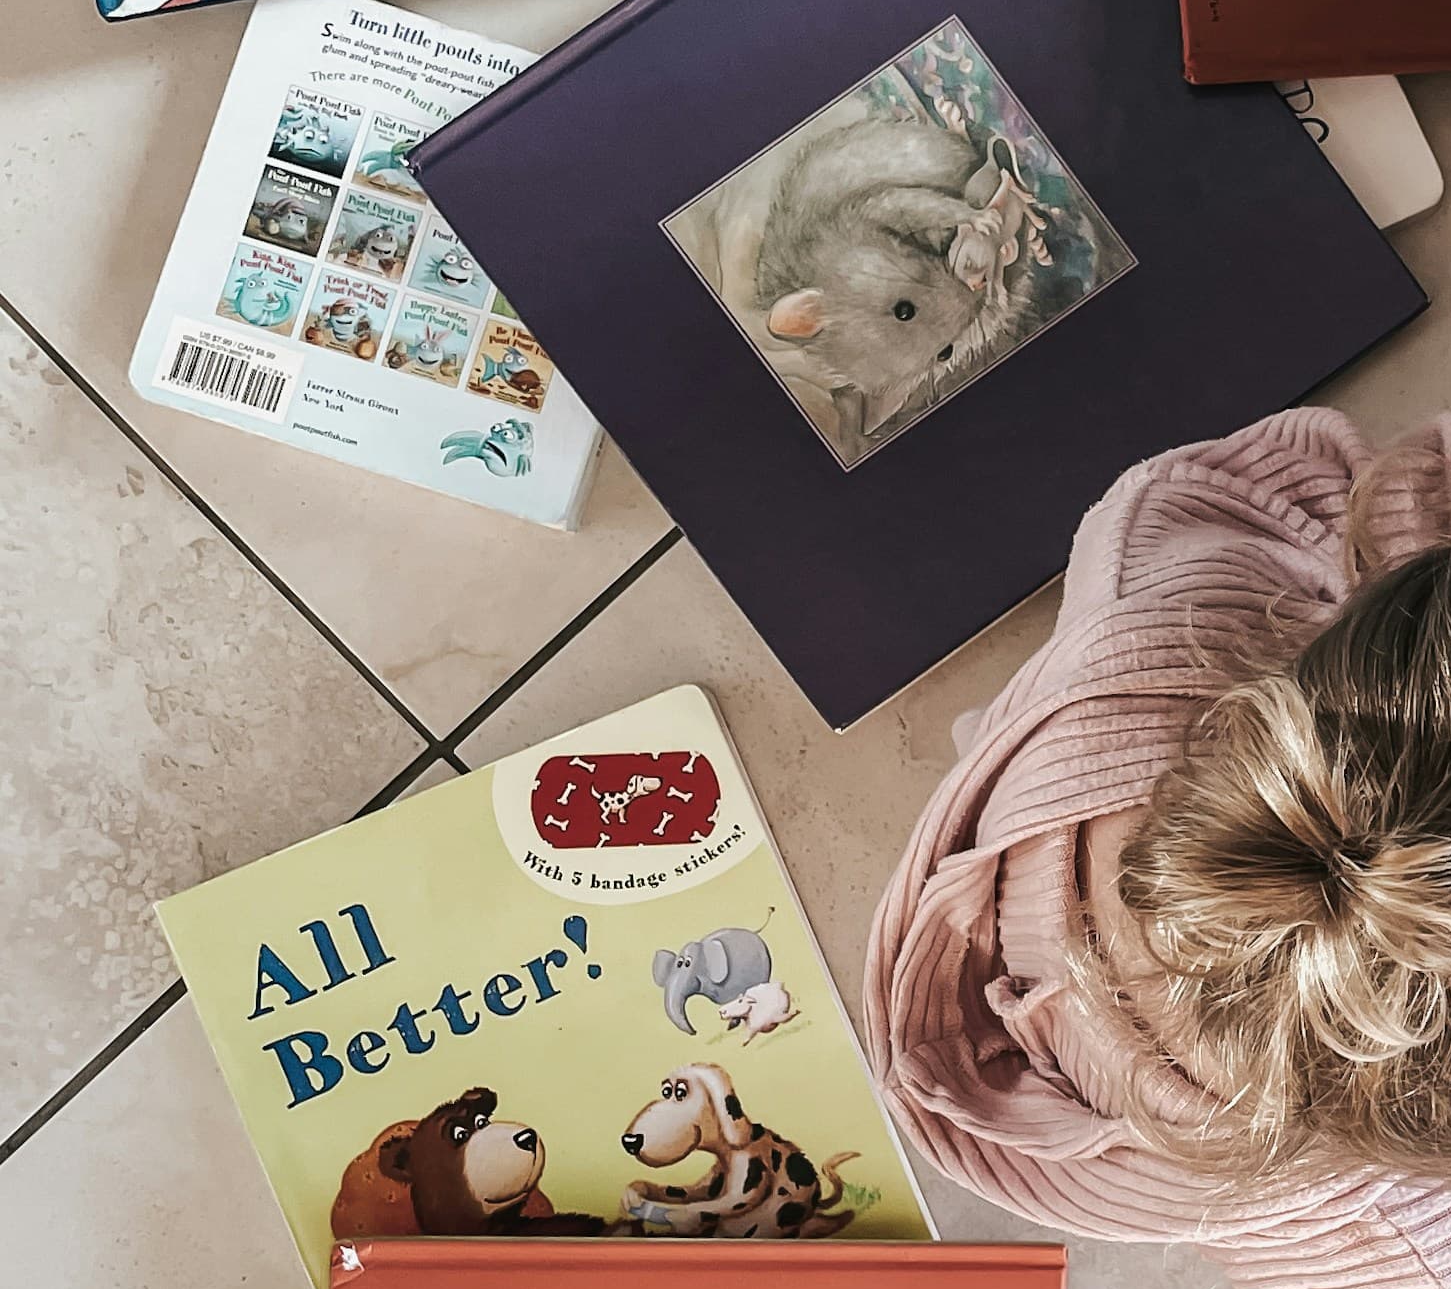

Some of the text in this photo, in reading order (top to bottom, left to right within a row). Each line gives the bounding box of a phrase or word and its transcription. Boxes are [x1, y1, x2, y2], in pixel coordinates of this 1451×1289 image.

[320, 21, 353, 44] Swim
[353, 38, 382, 56] along
[382, 47, 404, 60] with
[406, 54, 423, 67] the
[476, 75, 496, 90] fish
[348, 9, 389, 36] Turn
[391, 22, 432, 48] little
[434, 40, 484, 66] pouts
[308, 66, 346, 87] There
[348, 71, 370, 84] are
[371, 76, 403, 94] more
[523, 824, 748, 890] With 5 bandage stickers!
[247, 902, 397, 1022] All
[261, 914, 603, 1110] Better!
